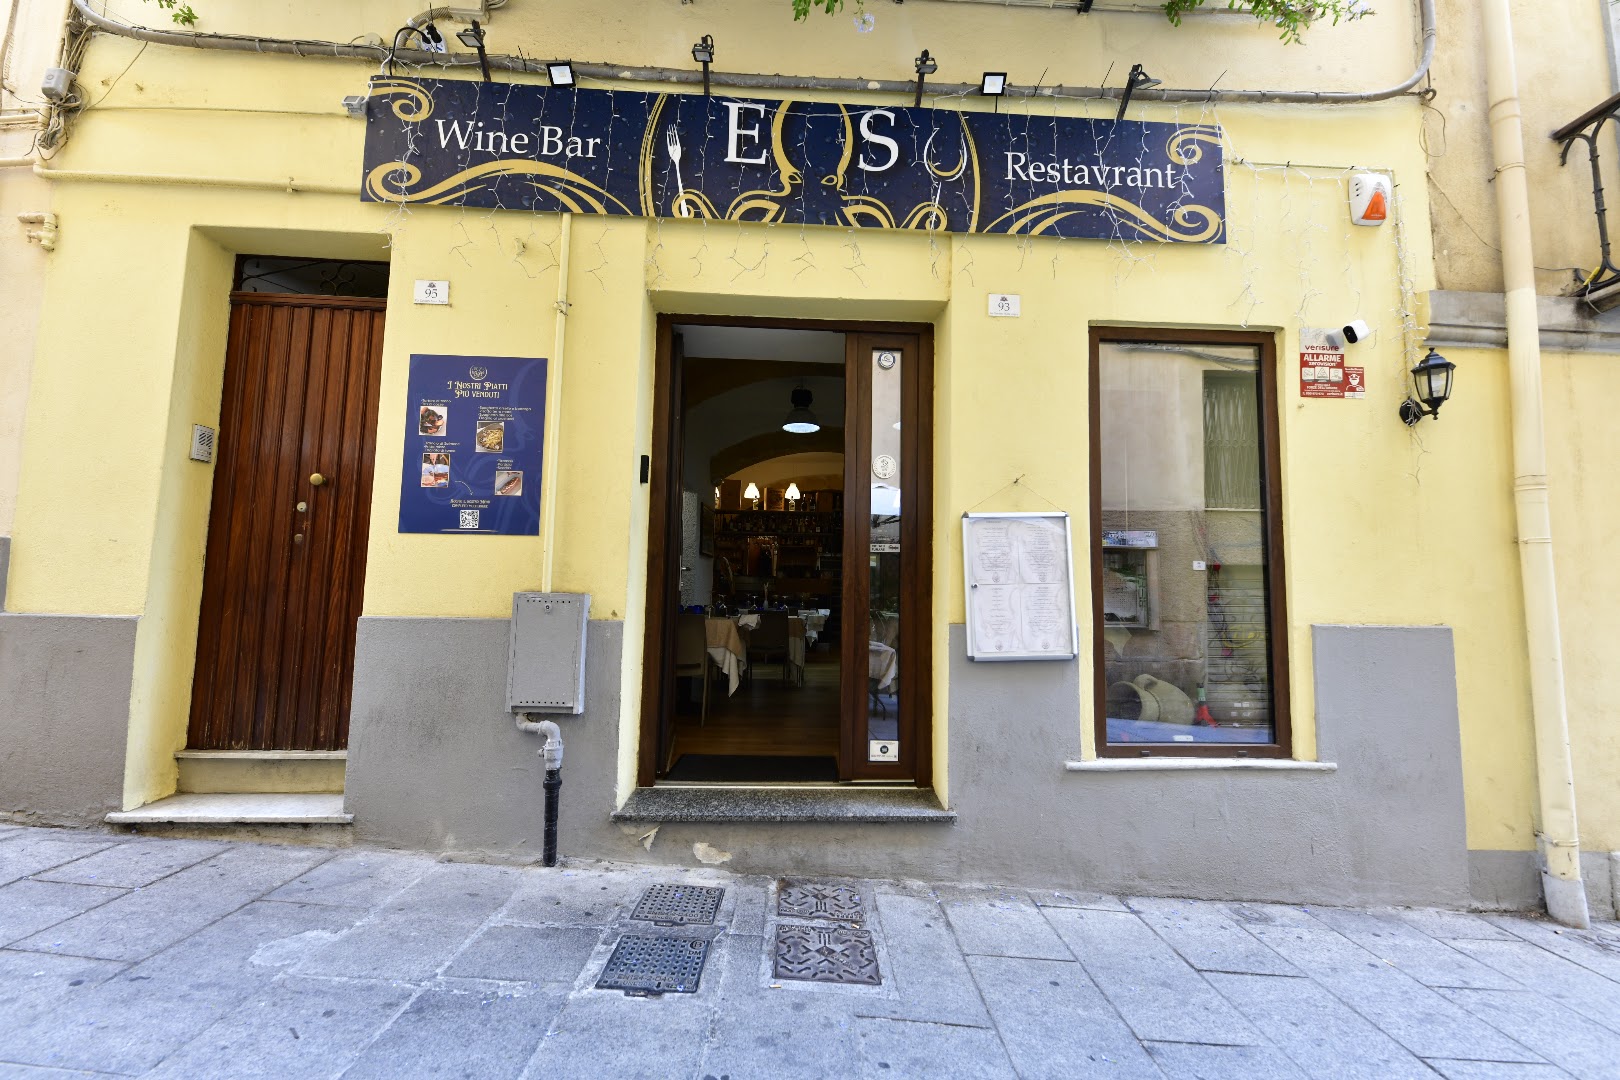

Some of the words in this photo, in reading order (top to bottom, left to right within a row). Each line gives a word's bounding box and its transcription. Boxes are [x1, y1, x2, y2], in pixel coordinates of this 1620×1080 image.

[435, 119, 529, 154] Wine
[540, 126, 600, 158] Bar
[425, 288, 438, 298] 95
[998, 302, 1010, 311] 93
[1303, 354, 1342, 362] ALLARME
